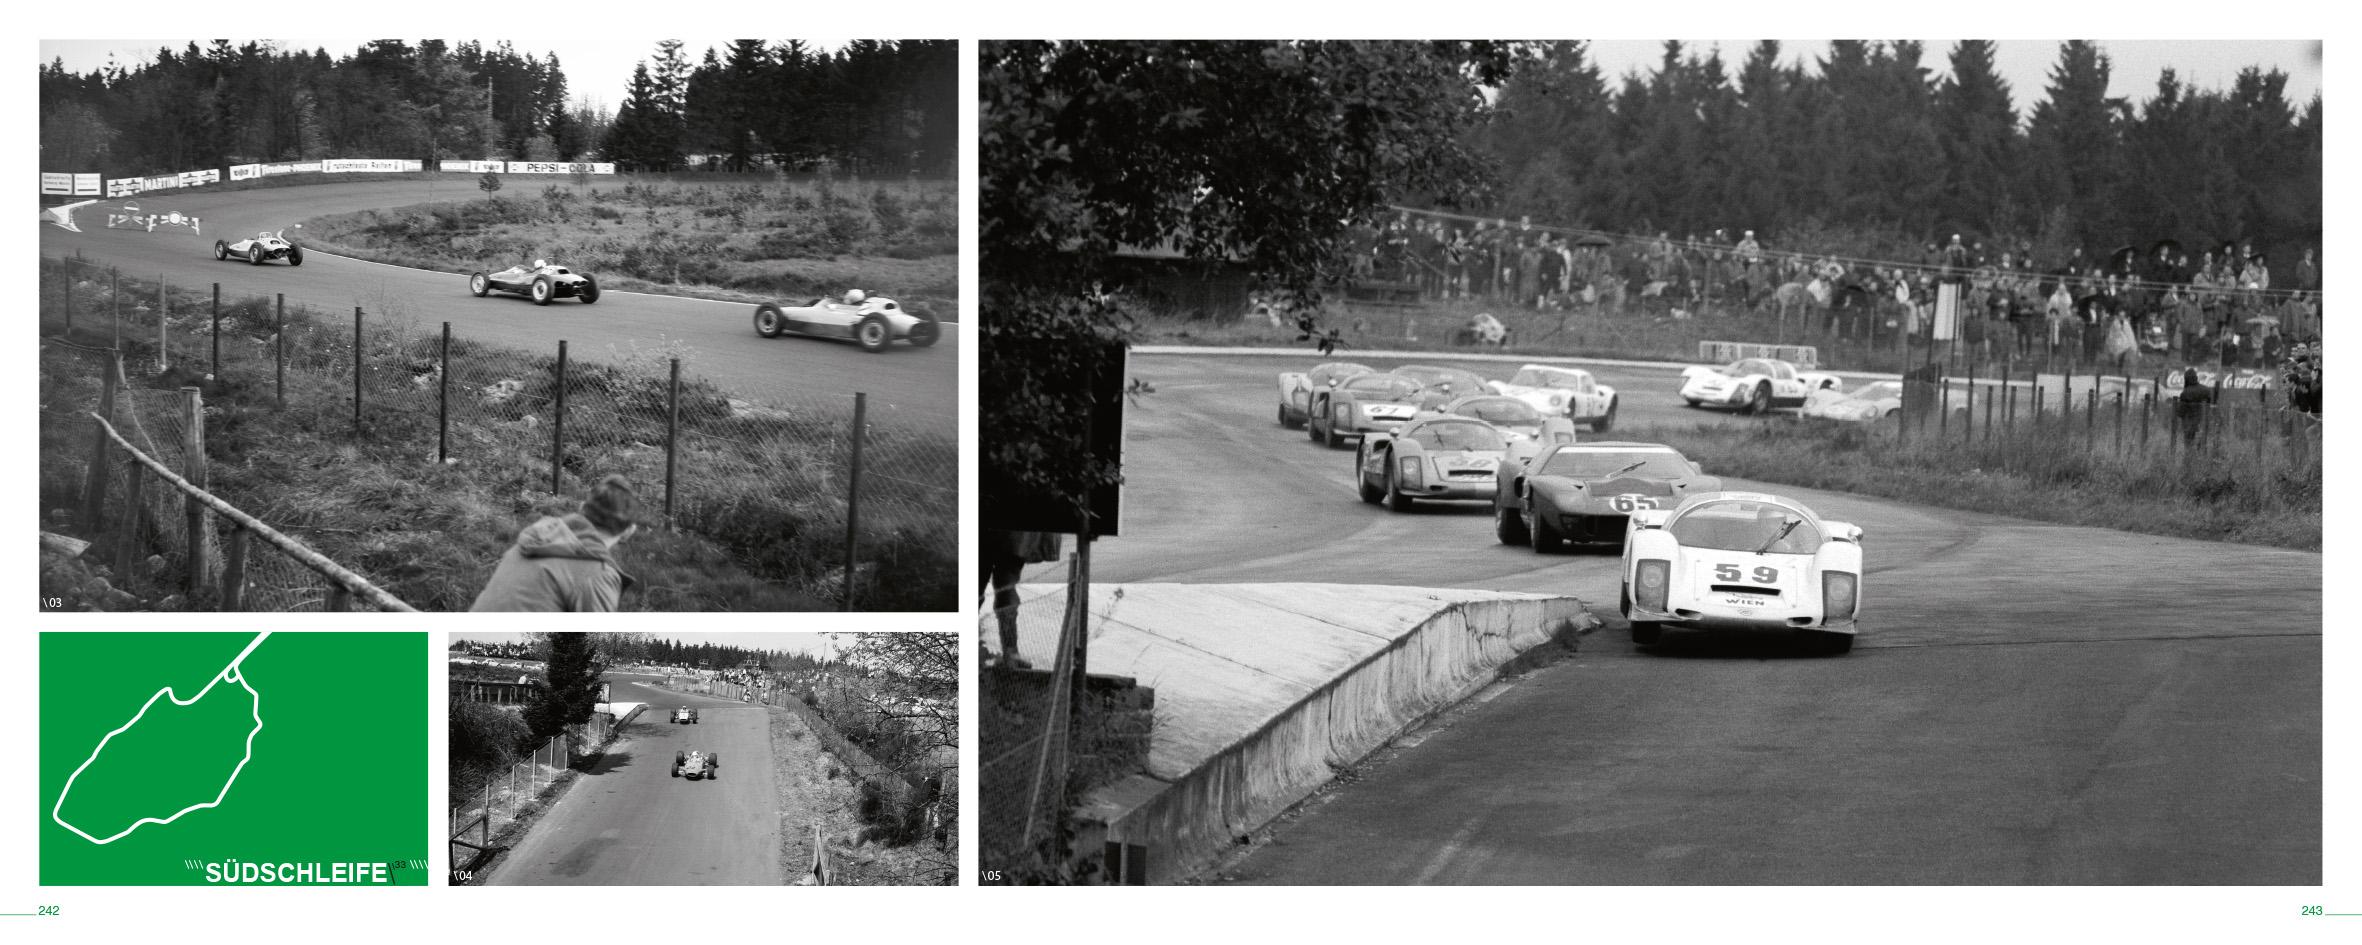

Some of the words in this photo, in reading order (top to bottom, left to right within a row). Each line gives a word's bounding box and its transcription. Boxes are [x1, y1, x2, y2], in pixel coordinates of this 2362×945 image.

[143, 176, 179, 191] MARTINI
[1713, 563, 1779, 584] 59
[1726, 598, 1765, 606] WIEN
